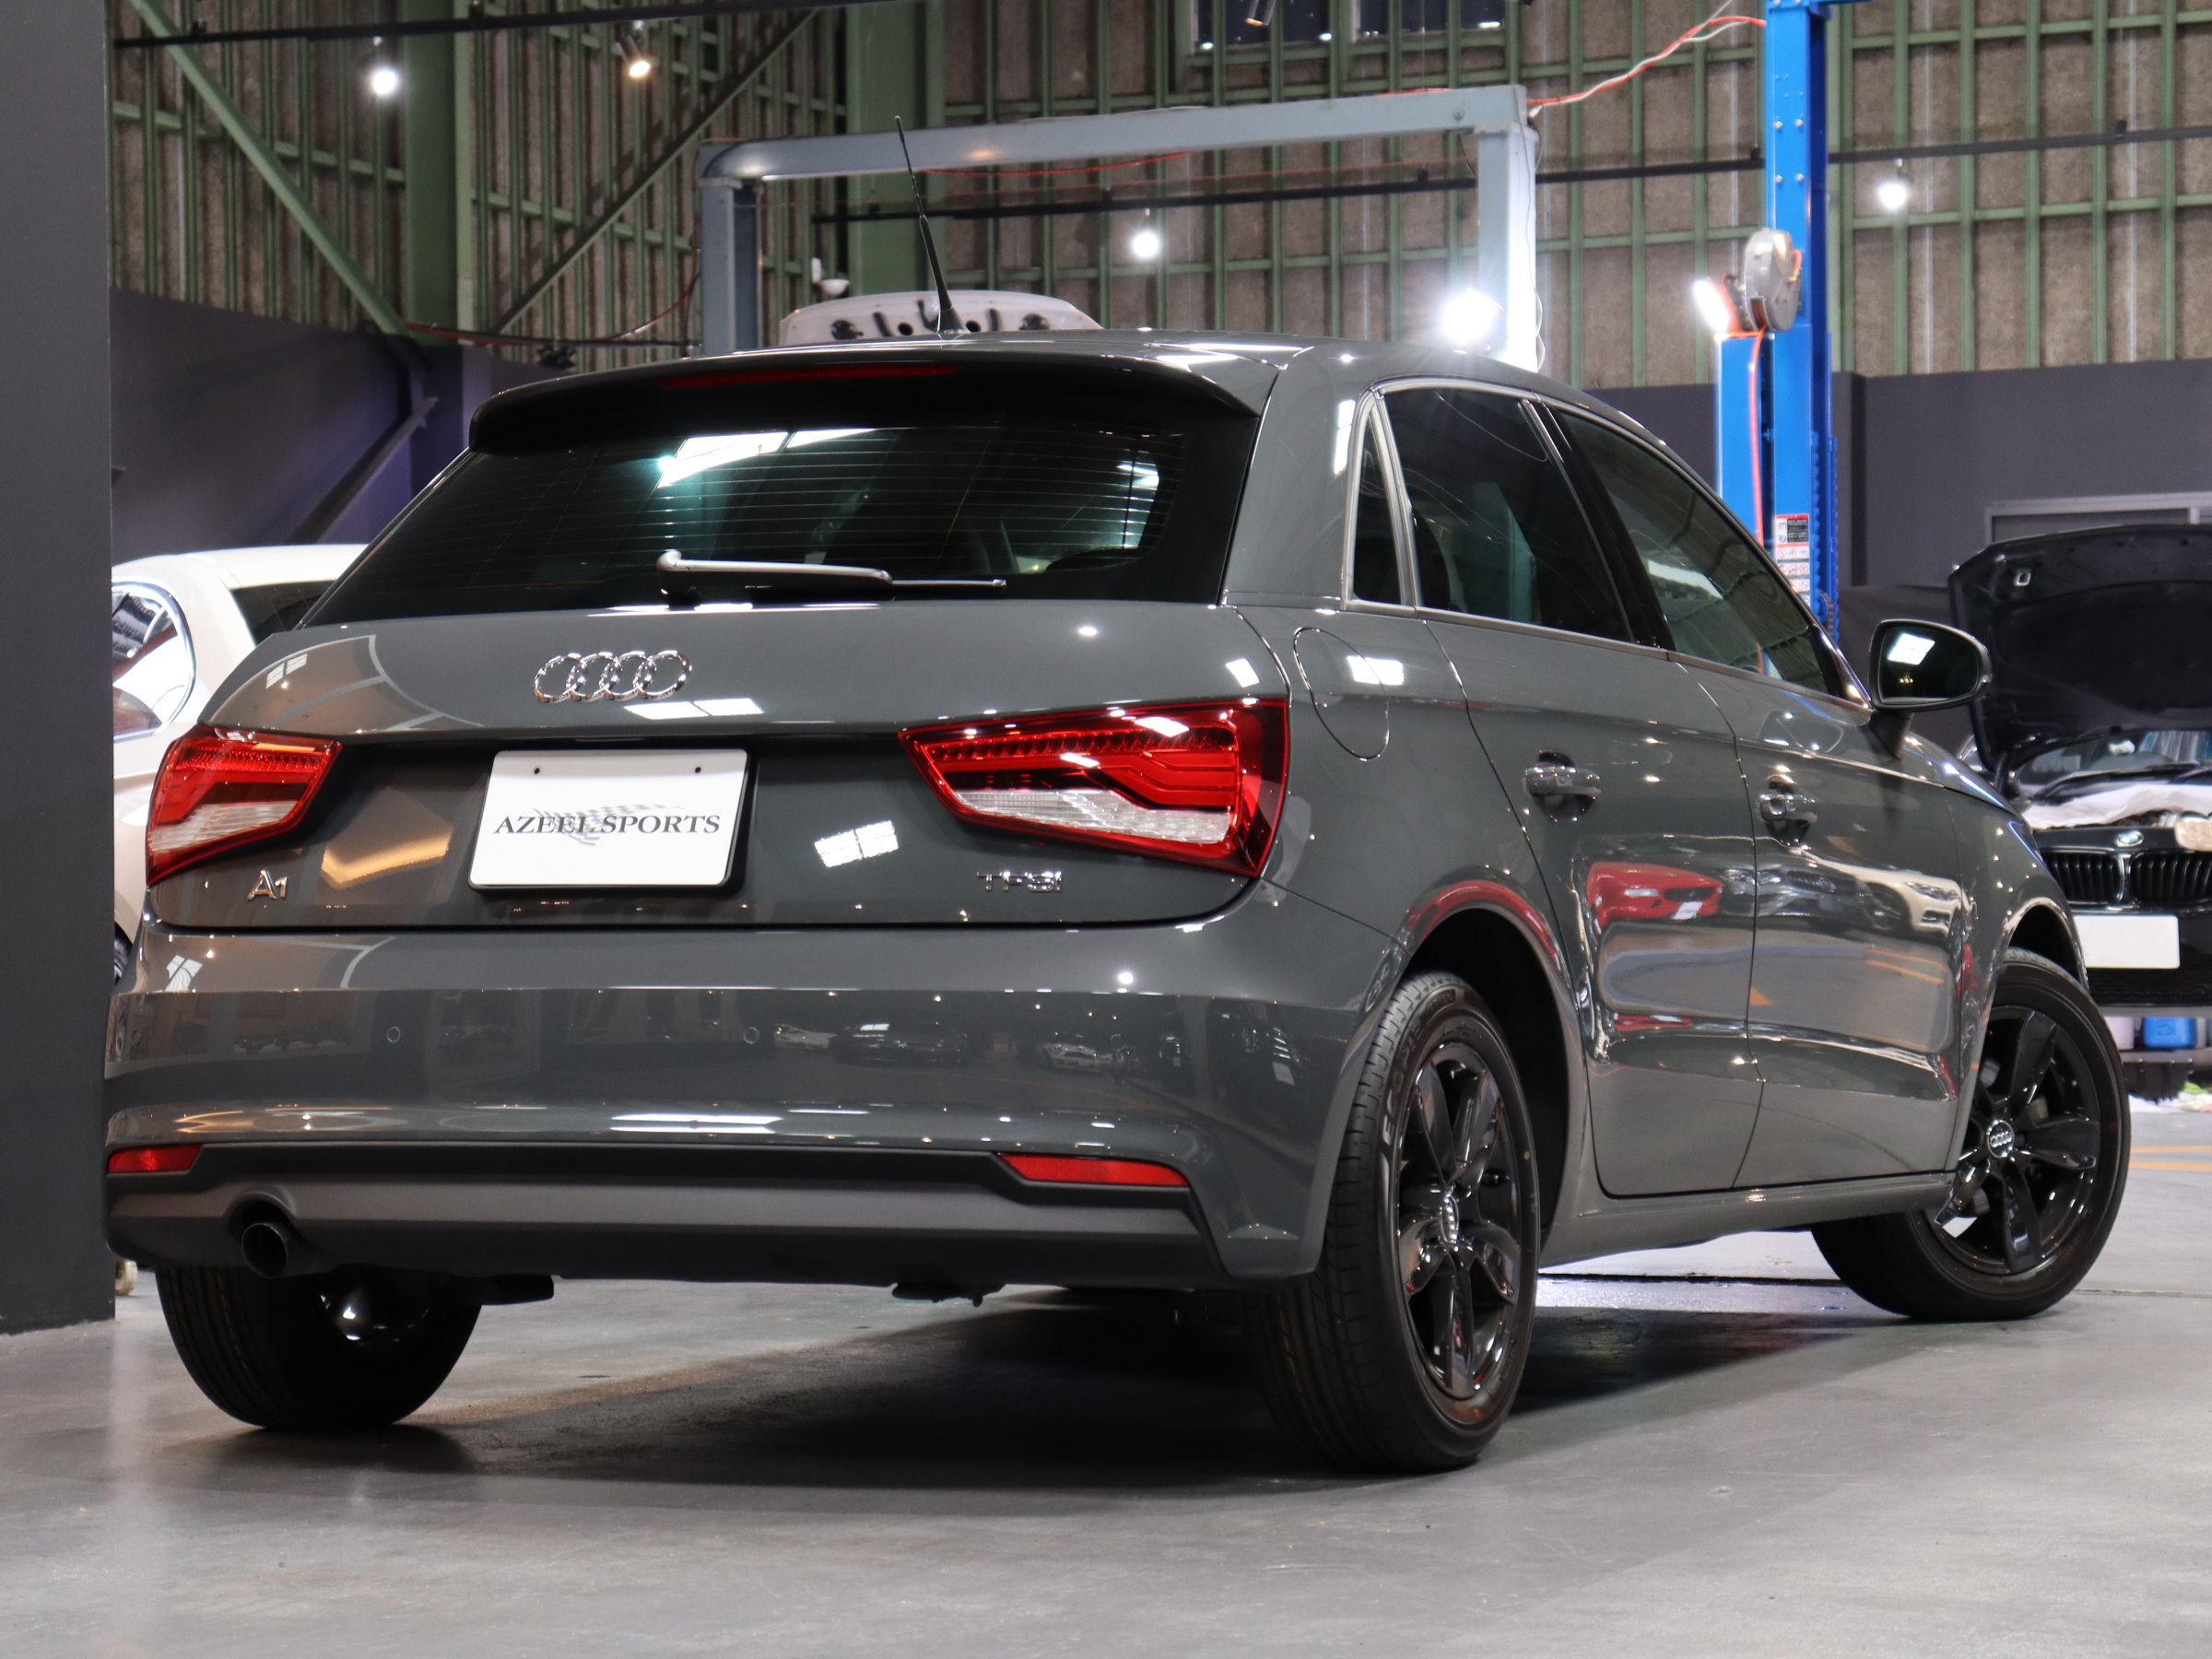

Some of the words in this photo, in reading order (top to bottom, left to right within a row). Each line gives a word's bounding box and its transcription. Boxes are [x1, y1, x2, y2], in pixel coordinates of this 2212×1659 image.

[495, 816, 598, 833] AZEEL
[601, 815, 721, 833] SPORTS
[247, 870, 288, 900] A1
[977, 871, 1062, 892] TFSI
